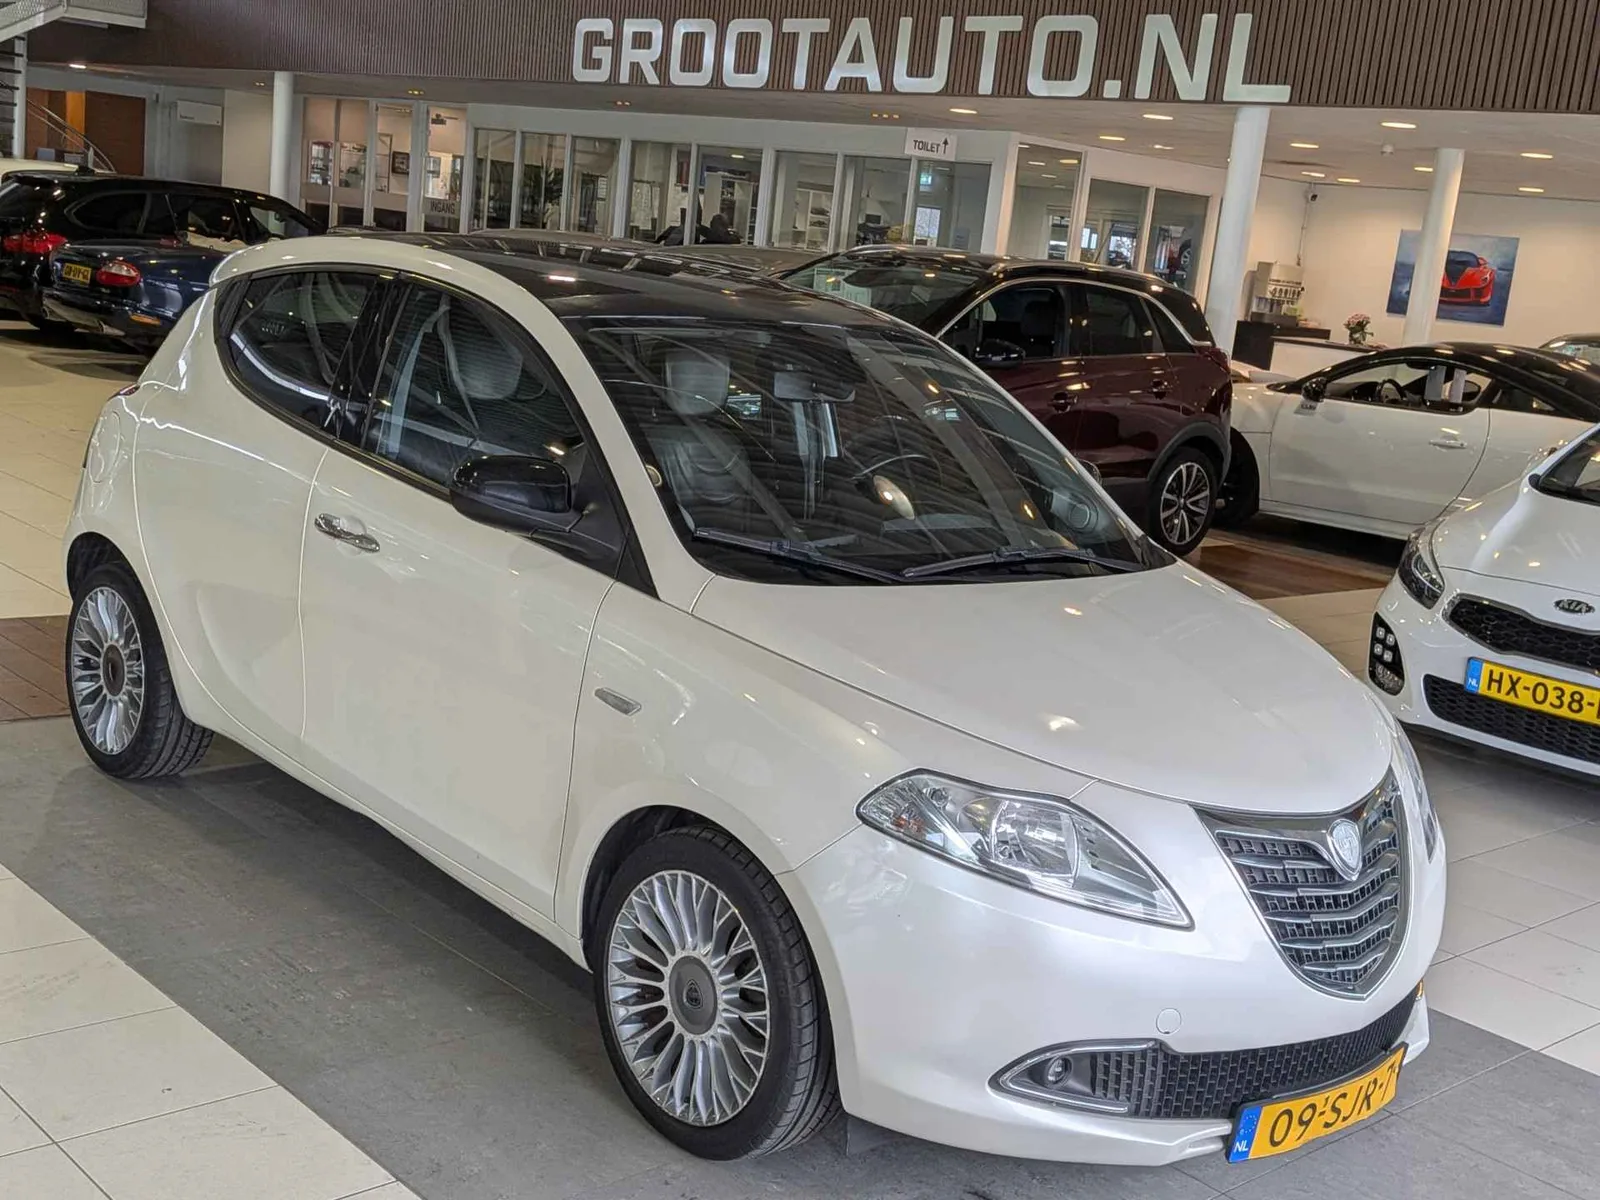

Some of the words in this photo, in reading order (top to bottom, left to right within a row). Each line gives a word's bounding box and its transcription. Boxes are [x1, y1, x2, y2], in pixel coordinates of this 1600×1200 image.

[572, 13, 1292, 103] GROOTAUTO.NL
[913, 139, 941, 154] TOILET
[430, 200, 456, 215] INGANG
[1558, 600, 1588, 613] KIA
[1468, 677, 1478, 687] NL
[1486, 668, 1600, 720] HX-038-
[1234, 1140, 1249, 1153] NL
